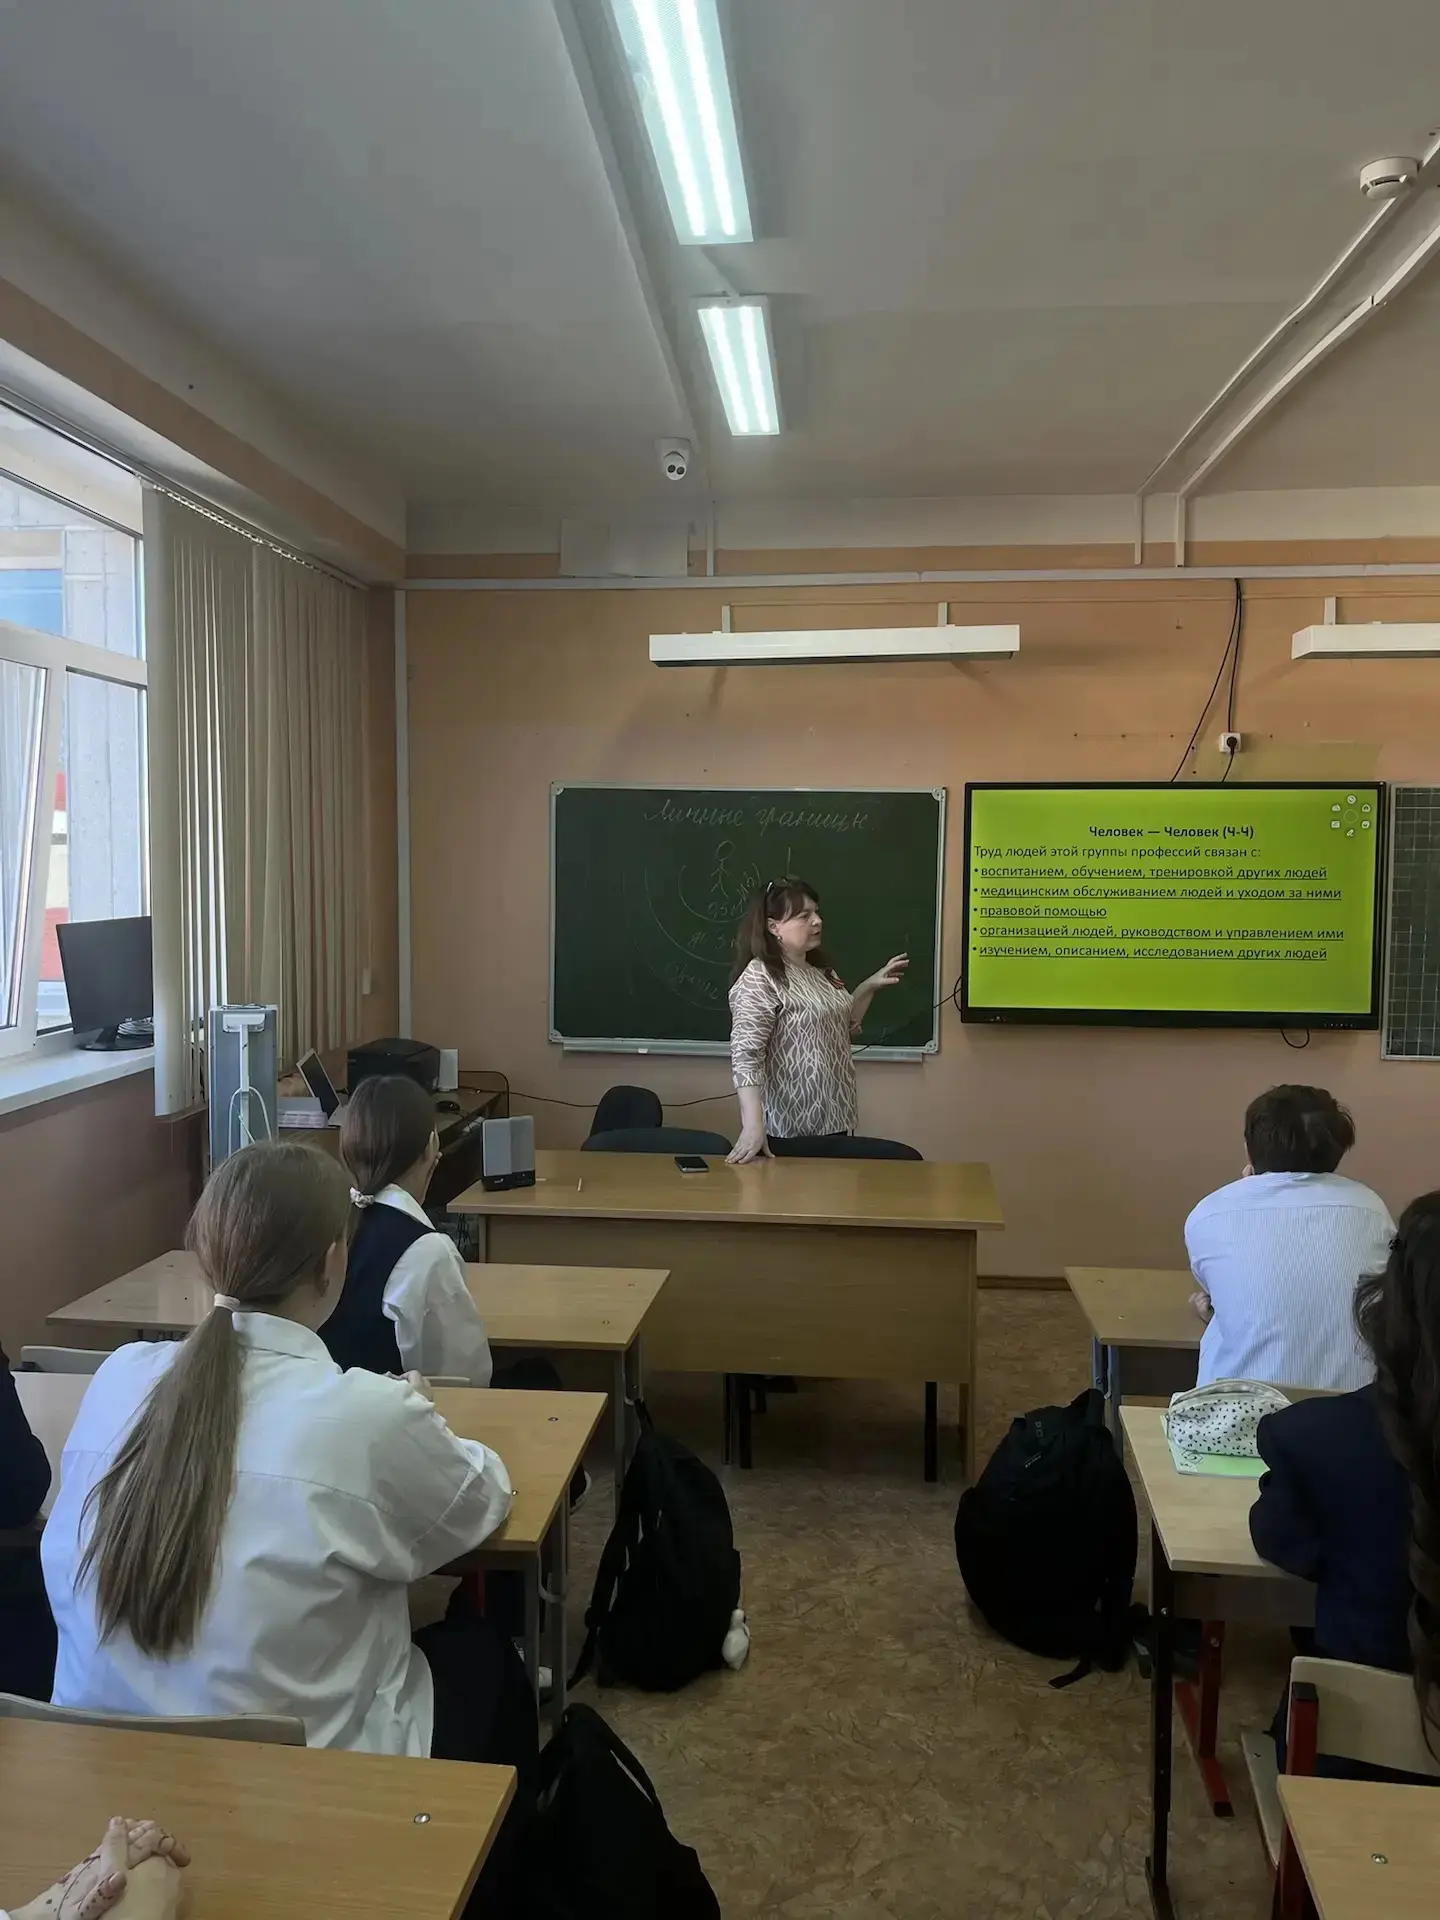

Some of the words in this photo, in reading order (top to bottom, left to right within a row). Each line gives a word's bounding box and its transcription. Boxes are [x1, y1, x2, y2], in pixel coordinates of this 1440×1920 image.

[1089, 826, 1144, 837] Человек
[1164, 826, 1219, 838] Человек
[1223, 826, 1254, 840] (Ч-Ч)
[974, 845, 1003, 858] Труд
[1005, 846, 1047, 858] людей
[1051, 846, 1079, 857] этой
[1082, 848, 1128, 859] группы
[1131, 846, 1201, 859] профессий
[1204, 848, 1247, 858] связан
[1250, 848, 1262, 858] с:
[981, 868, 1068, 878] воспитанием,
[1071, 866, 1147, 878] обучением,
[1149, 867, 1233, 878] тренировкой
[1236, 868, 1281, 880] других
[1284, 867, 1328, 880] людей
[980, 888, 1070, 898] медицинским
[1073, 886, 1177, 899] обслуживанием
[1180, 886, 1222, 898] людей
[1226, 889, 1234, 898] и
[1237, 889, 1285, 899] уходом
[1288, 889, 1303, 898] за
[1306, 889, 1342, 899] ними
[980, 905, 1041, 917] правовой
[1044, 907, 1107, 917] помощью
[980, 925, 1069, 936] организацией
[1072, 926, 1117, 938] людей,
[1121, 928, 1211, 939] руководством
[1215, 929, 1223, 938] и
[1226, 929, 1314, 940] управлением
[1317, 930, 1345, 939] ими
[979, 946, 1052, 957] изучением,
[1055, 947, 1130, 958] описанием,
[1133, 948, 1234, 958] исследованием
[1237, 949, 1281, 960] других
[1284, 948, 1328, 960] людей
